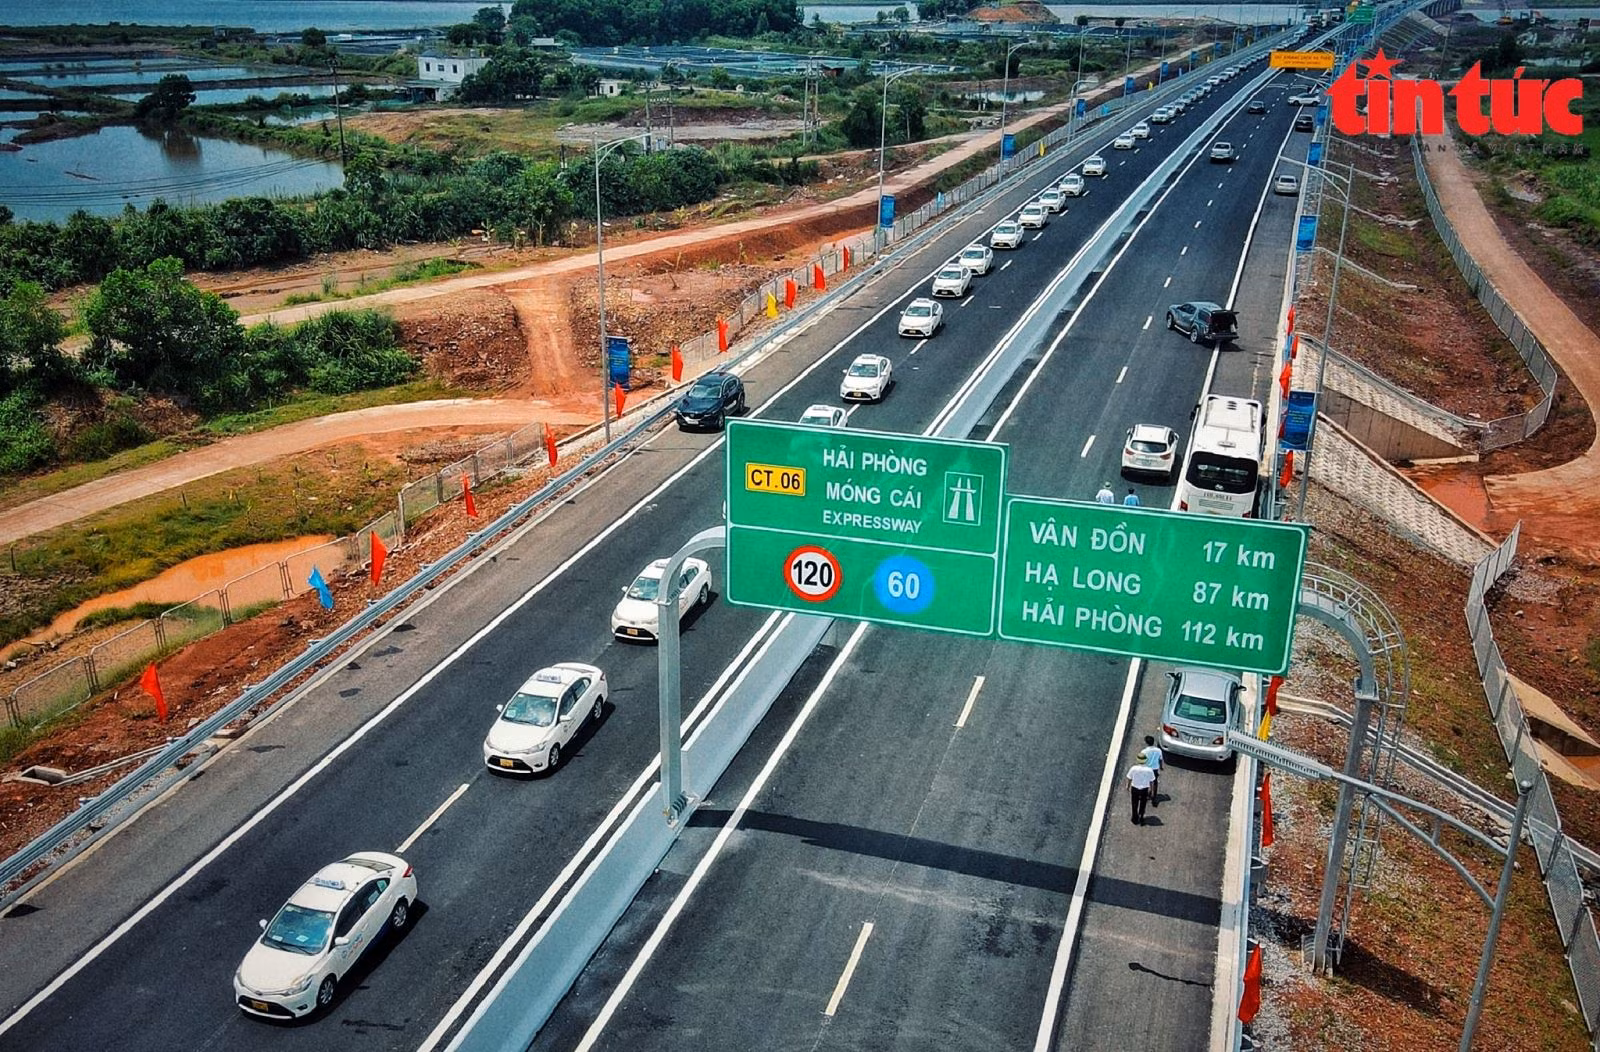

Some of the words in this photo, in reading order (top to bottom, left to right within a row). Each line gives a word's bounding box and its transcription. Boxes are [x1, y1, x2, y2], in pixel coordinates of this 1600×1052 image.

[823, 445, 854, 469] HẢI
[862, 449, 927, 476] PHÒNG
[751, 468, 801, 491] CT.06
[826, 478, 881, 505] MÓNG
[890, 485, 922, 509] CÁI
[823, 510, 922, 534] EXPRESSWAY
[1029, 517, 1078, 548] VÂN
[1090, 521, 1146, 555] ĐỒN
[1202, 541, 1228, 563] 17
[1236, 544, 1275, 570] km
[793, 560, 833, 588] 120
[888, 571, 920, 599] 60
[1025, 561, 1059, 591] HẠ
[1072, 566, 1141, 595] LONG
[1192, 581, 1222, 605] 87
[1231, 585, 1270, 611] km
[1022, 597, 1064, 626] HẢI
[1075, 604, 1163, 638] PHÒNG
[1181, 620, 1217, 645] 112
[1225, 626, 1265, 652] km
